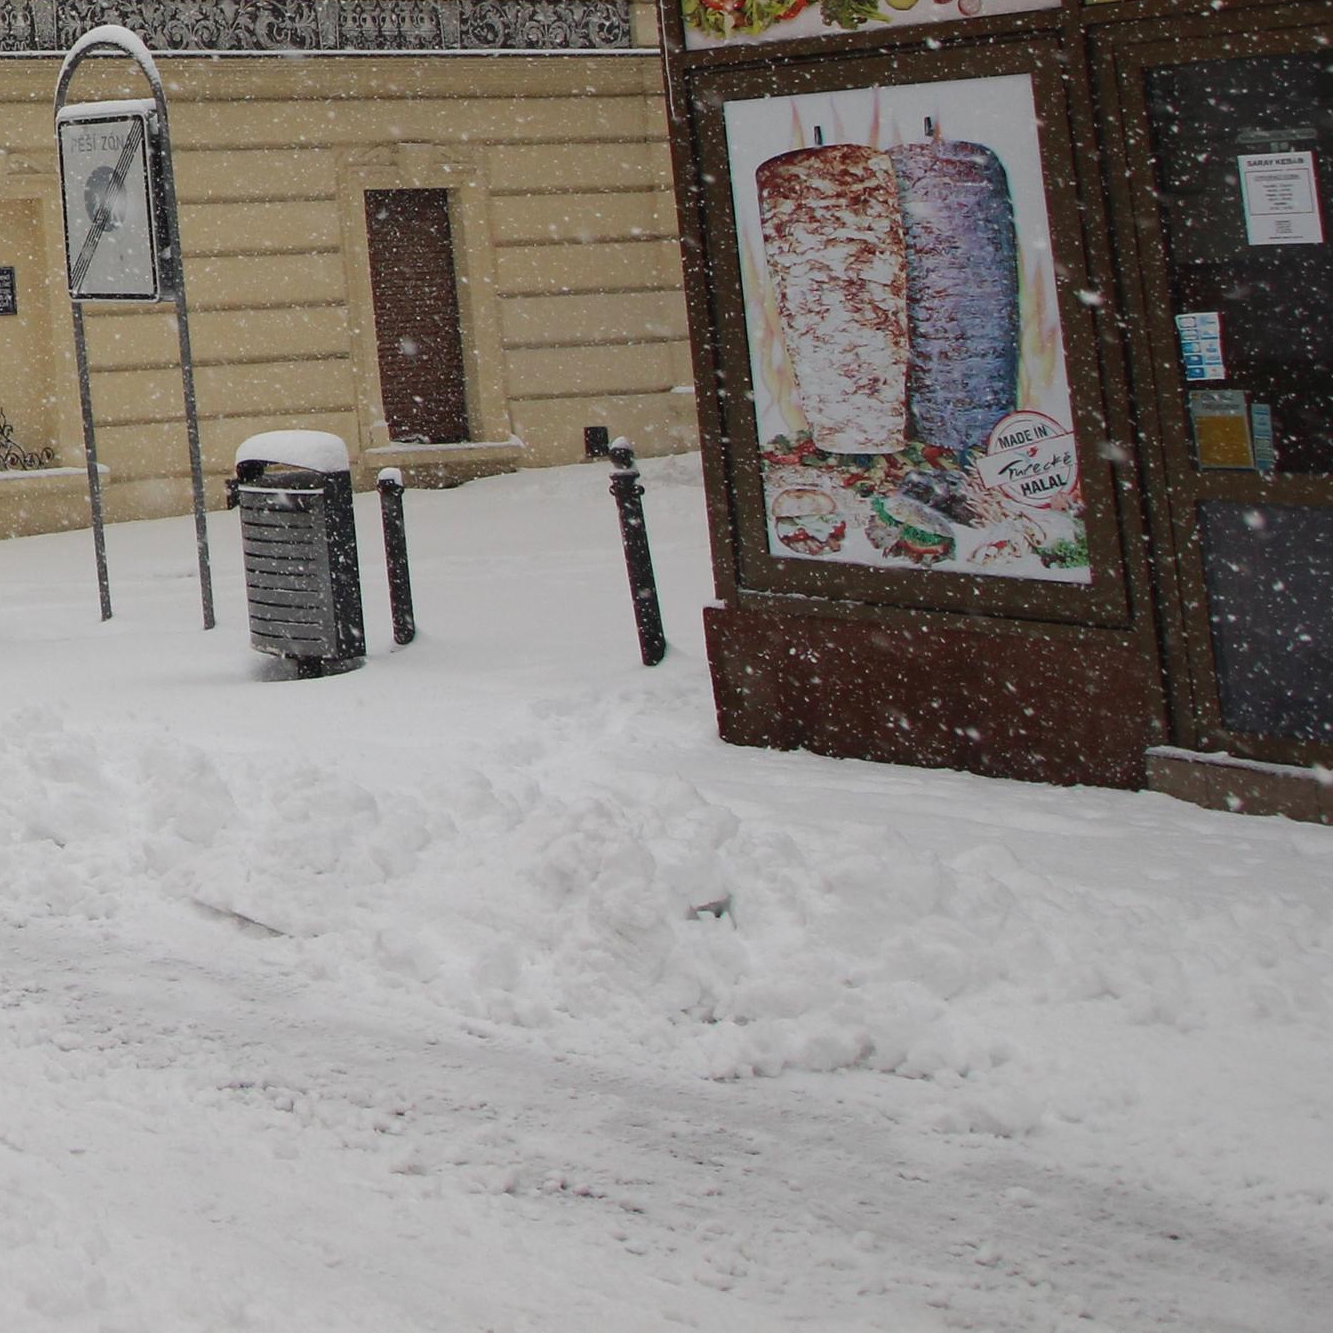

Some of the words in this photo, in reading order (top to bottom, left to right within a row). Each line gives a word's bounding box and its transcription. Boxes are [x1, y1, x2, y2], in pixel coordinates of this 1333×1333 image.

[998, 429, 1033, 449] MADE
[1035, 424, 1049, 439] IN
[1020, 474, 1067, 496] HALAL
